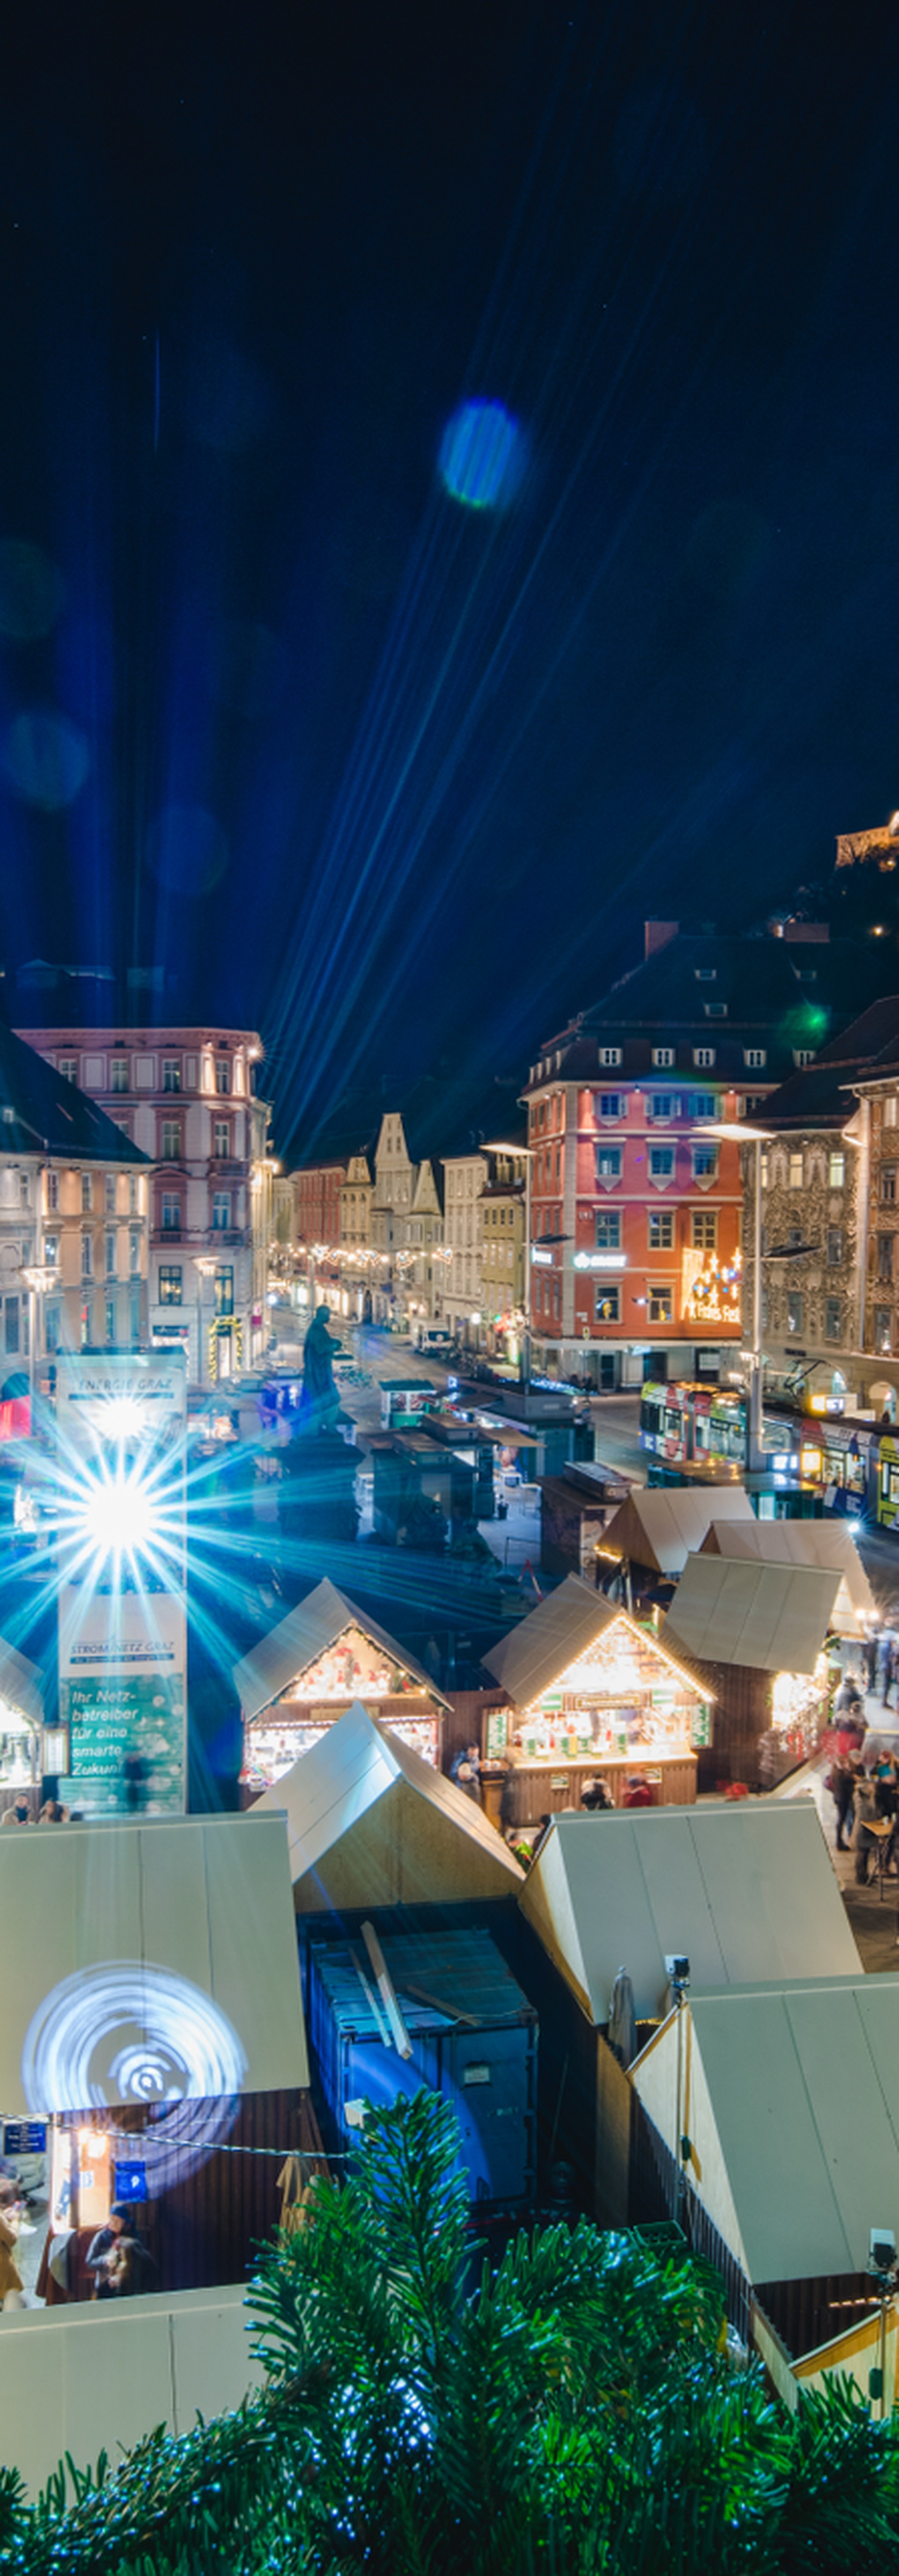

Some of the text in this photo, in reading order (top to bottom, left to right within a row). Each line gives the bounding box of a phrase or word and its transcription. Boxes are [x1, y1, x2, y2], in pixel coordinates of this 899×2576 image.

[138, 1378, 173, 1390] GRAZ
[145, 1641, 175, 1652] GRAZ
[72, 1690, 137, 1704] Ihr Netz-
[72, 1708, 139, 1722] betreiber
[72, 1726, 128, 1740] für eine
[72, 1744, 122, 1758] smarte
